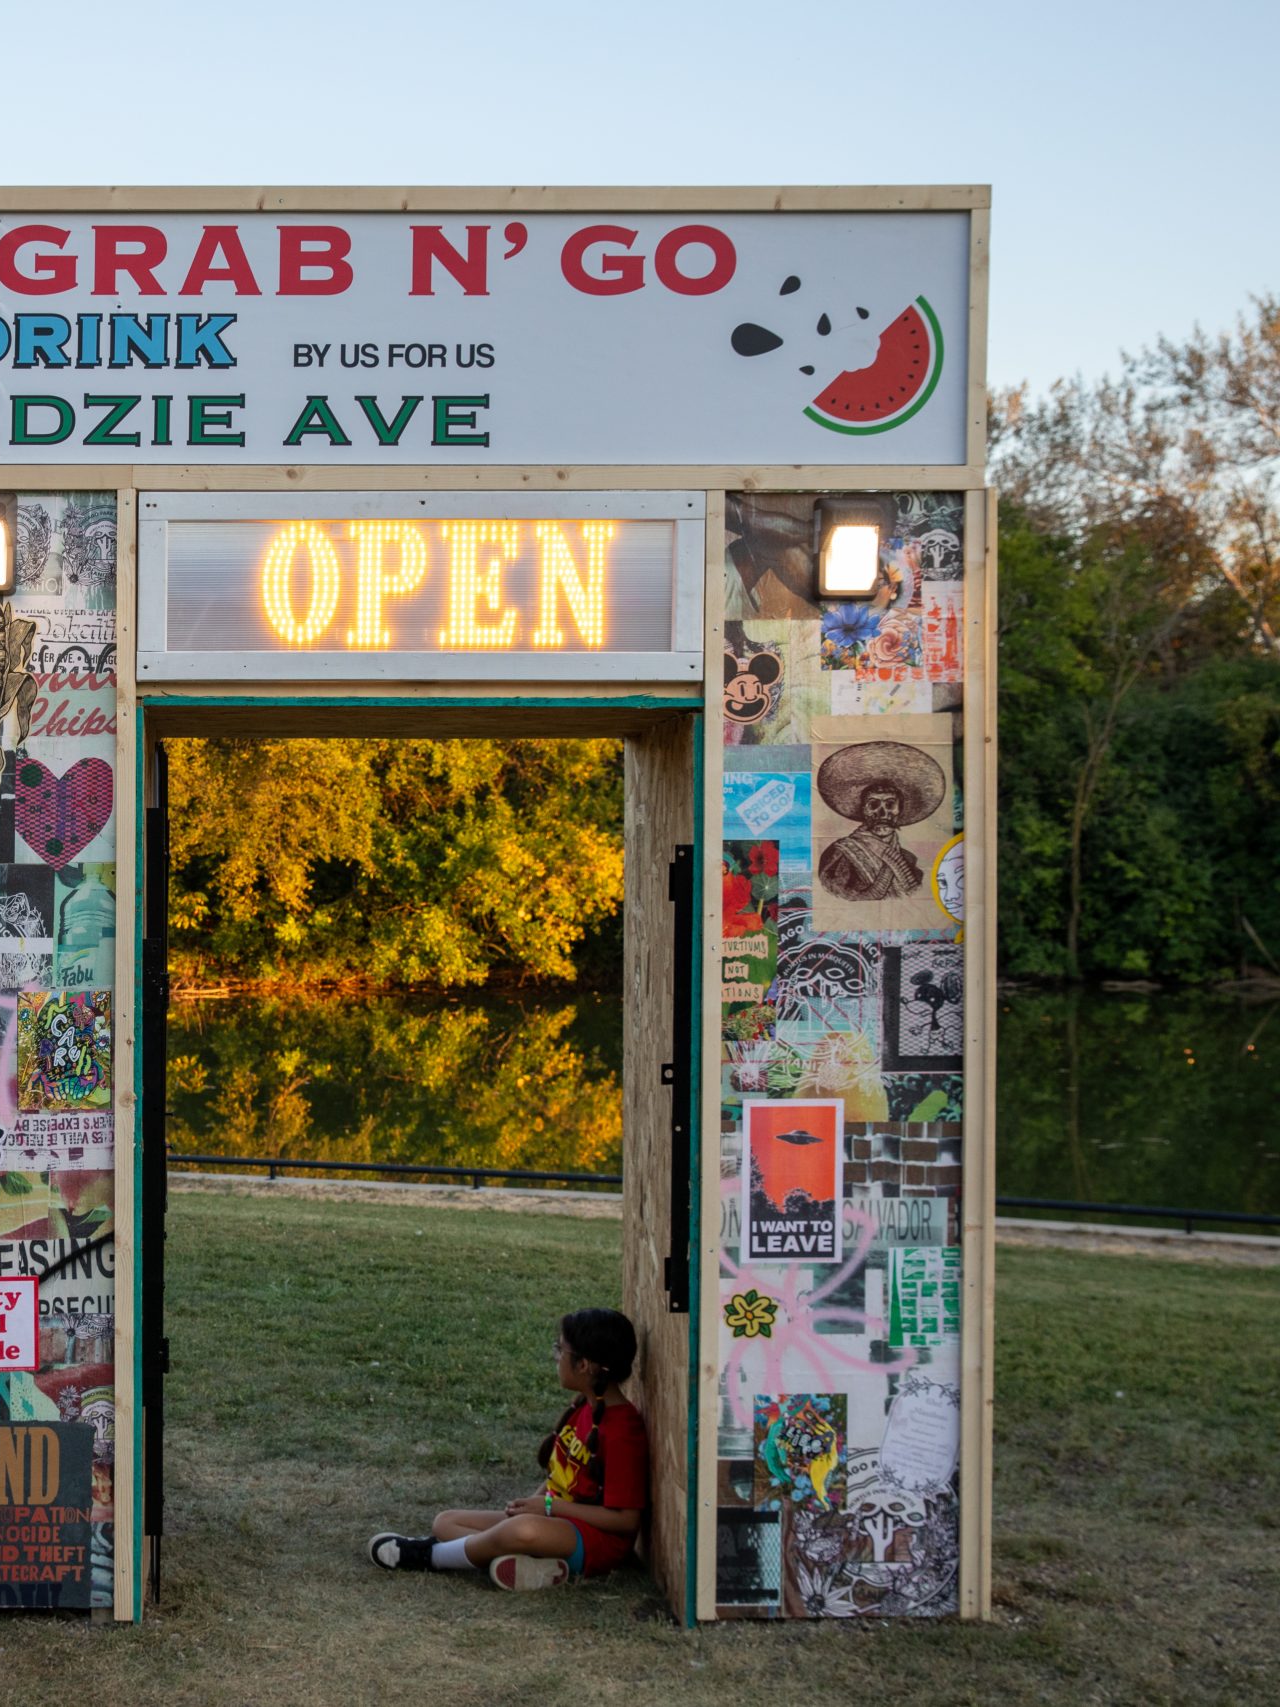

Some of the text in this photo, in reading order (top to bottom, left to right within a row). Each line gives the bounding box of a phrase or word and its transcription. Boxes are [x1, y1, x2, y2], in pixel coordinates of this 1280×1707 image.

[409, 221, 528, 297] N'
[560, 223, 738, 297] GO
[293, 343, 333, 369] BY
[340, 343, 380, 369] US
[388, 343, 448, 369] FOR
[456, 343, 496, 369] US
[283, 393, 492, 448] AVE
[261, 519, 616, 648] OPEN
[743, 783, 786, 819] PRICED
[751, 811, 770, 827] TO
[728, 965, 745, 975] NOT
[752, 1220, 834, 1232] I WANT TO
[842, 1200, 933, 1241] SALVADOR
[751, 1235, 833, 1253] LEAVE
[23, 1545, 86, 1563] THEFT
